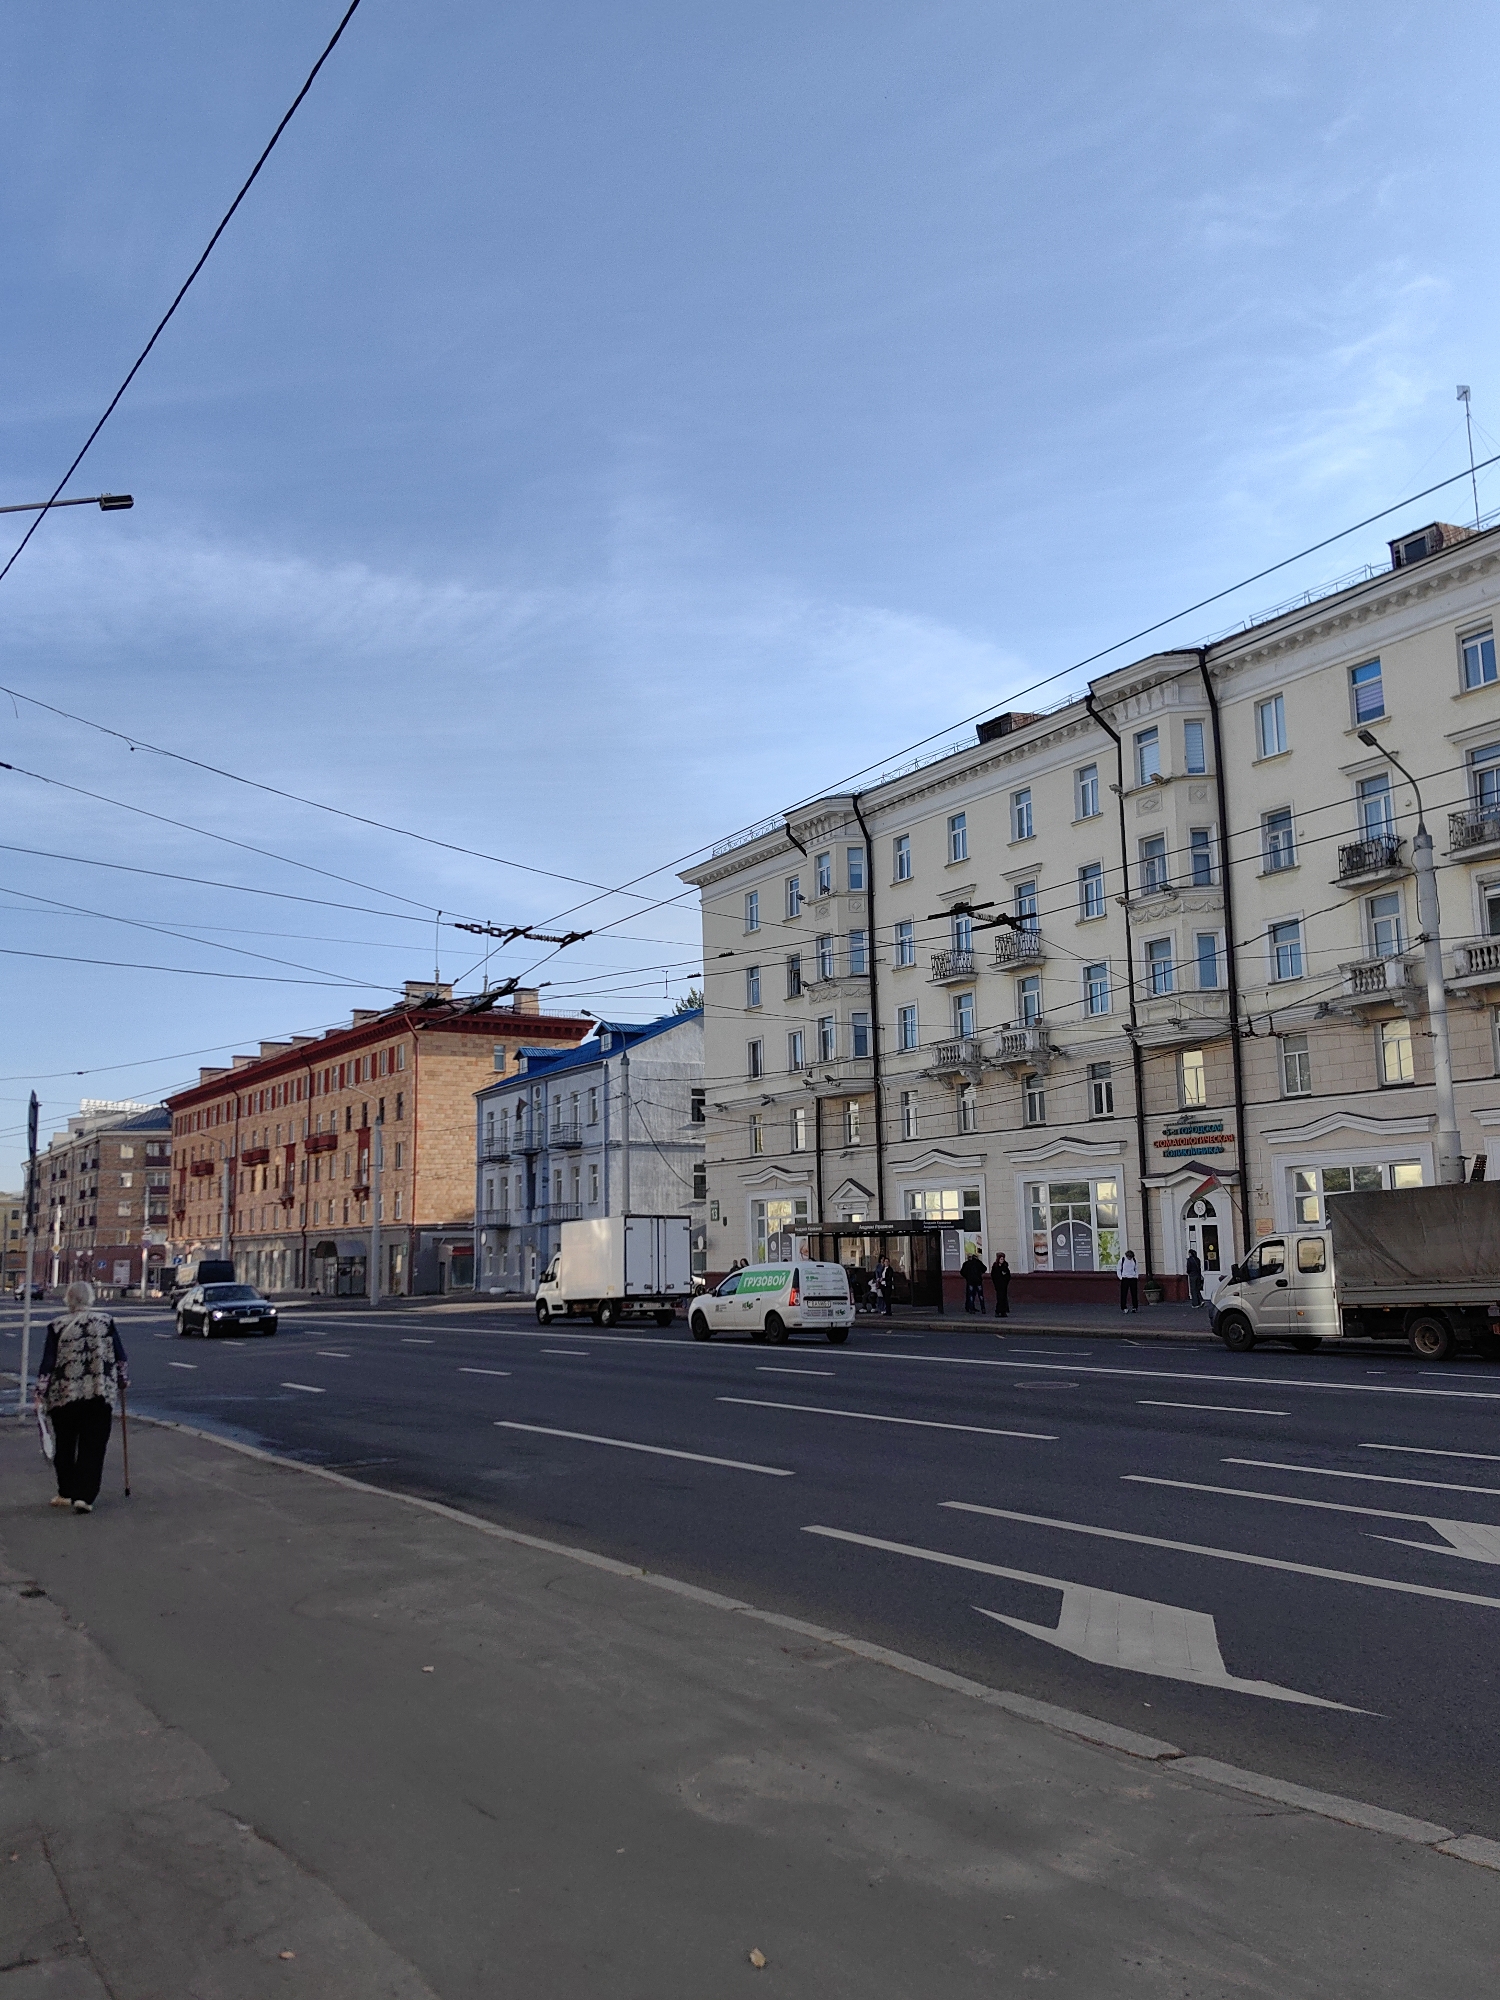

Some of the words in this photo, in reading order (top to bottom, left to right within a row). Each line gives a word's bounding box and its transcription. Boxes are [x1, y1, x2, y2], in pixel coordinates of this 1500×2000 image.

[1178, 1124, 1224, 1135] ГОРОДСКАЯ
[711, 1208, 718, 1220] 13
[743, 1272, 786, 1288] ГРУЗОВОЙ
